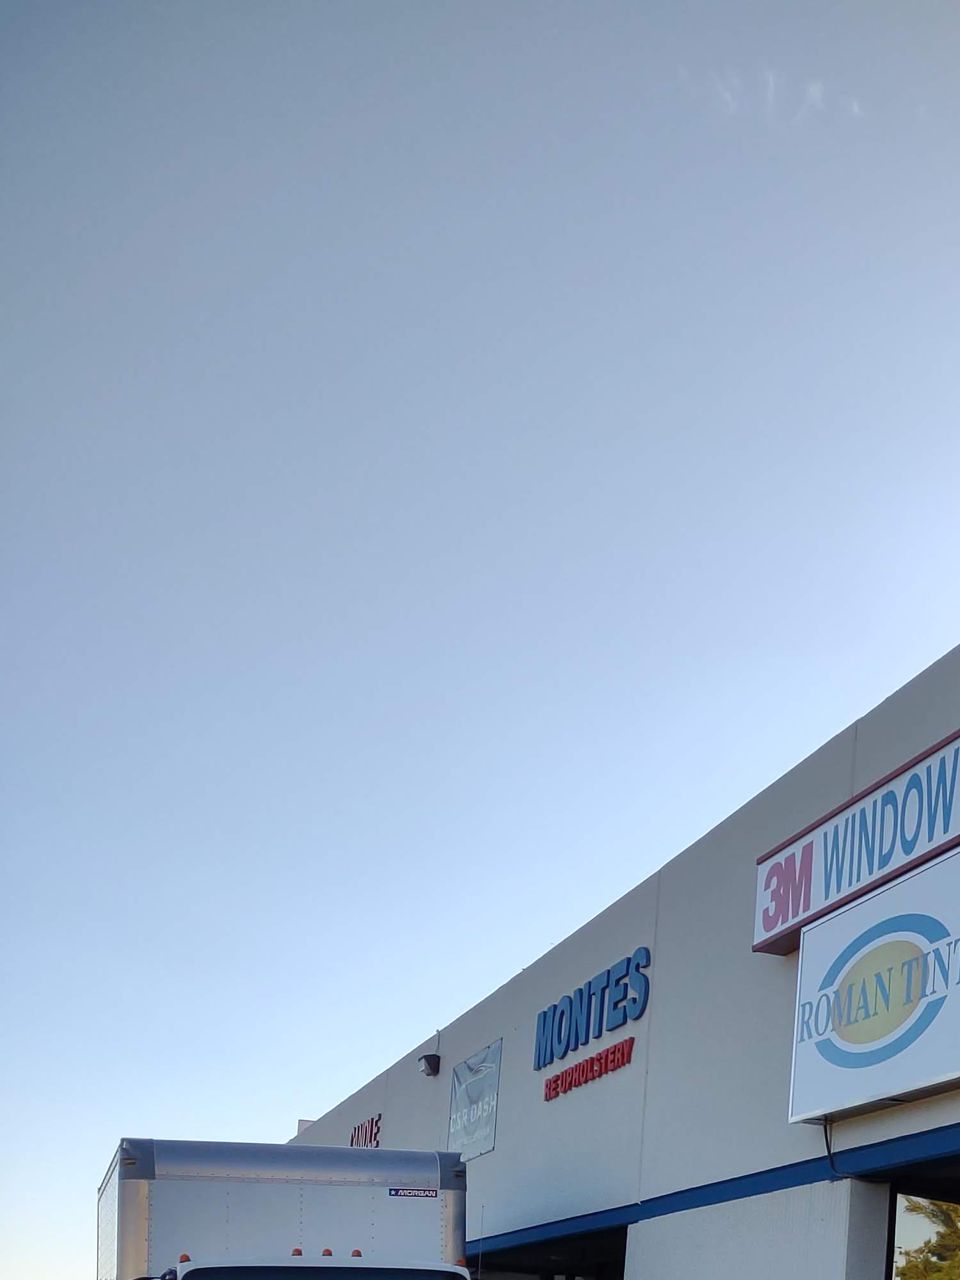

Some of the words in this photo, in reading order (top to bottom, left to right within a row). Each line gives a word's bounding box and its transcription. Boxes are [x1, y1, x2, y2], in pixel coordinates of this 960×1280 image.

[762, 841, 814, 933] 3M
[822, 745, 960, 901] WINDOW
[533, 946, 651, 1072] MONTES
[798, 967, 894, 1044] ROMAN
[397, 1189, 437, 1197] MORGAN
